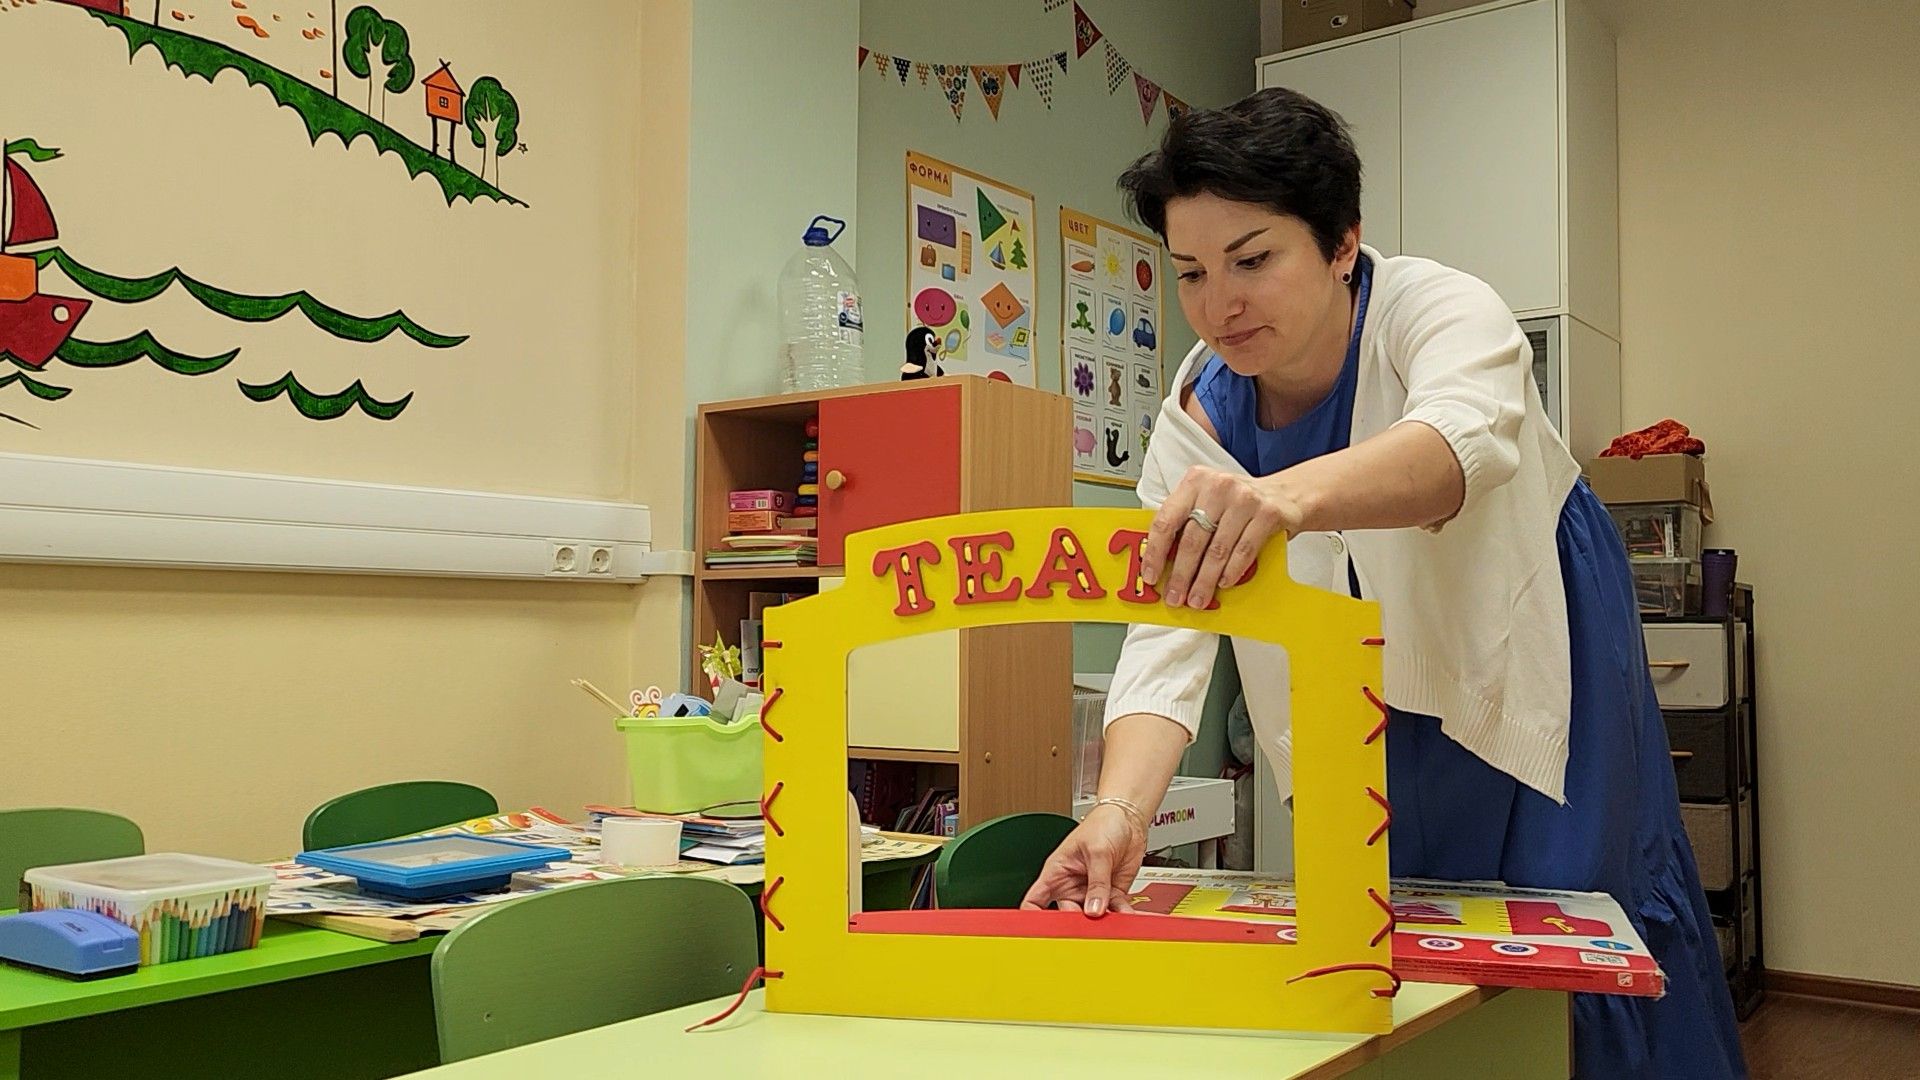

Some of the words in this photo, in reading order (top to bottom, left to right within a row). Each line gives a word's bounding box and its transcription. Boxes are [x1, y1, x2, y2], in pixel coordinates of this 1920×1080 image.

[909, 162, 950, 185] ФОРМА
[1068, 219, 1089, 235] ЦВЕТ
[871, 527, 1258, 616] ТЕАТ
